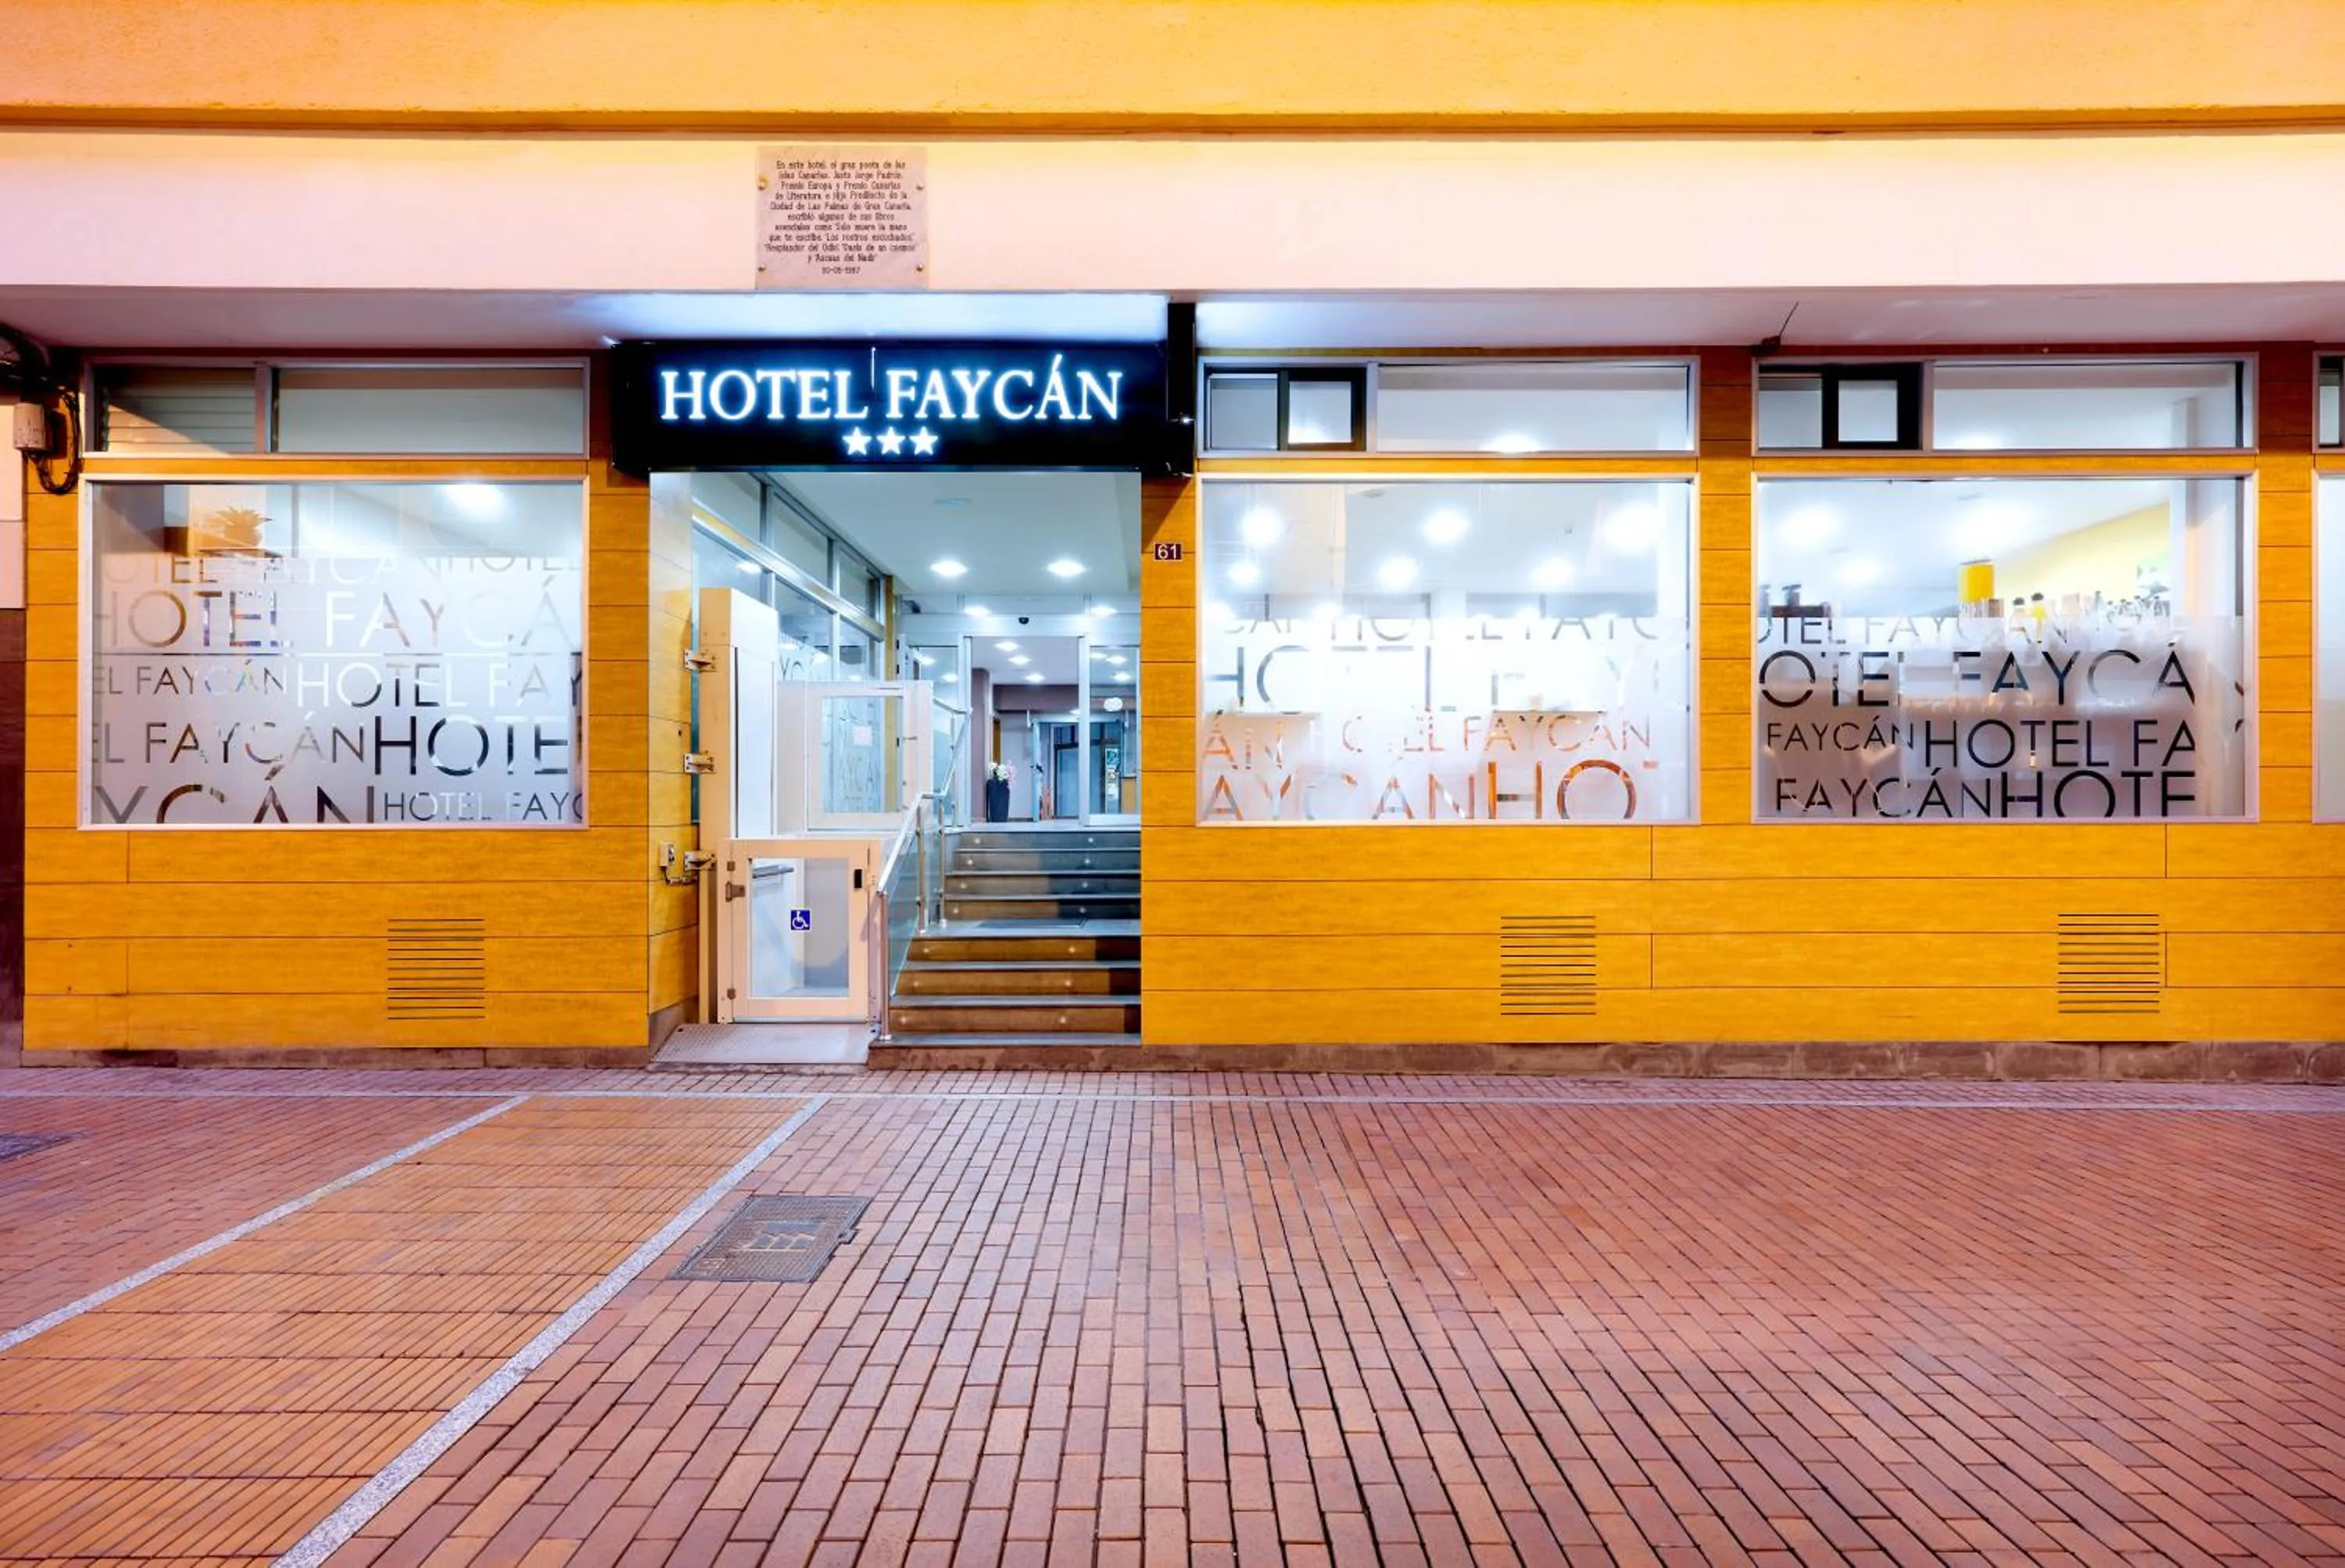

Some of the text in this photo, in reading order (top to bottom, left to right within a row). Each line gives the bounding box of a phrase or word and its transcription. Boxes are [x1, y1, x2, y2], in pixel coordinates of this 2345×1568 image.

[788, 160, 804, 170] este
[830, 159, 836, 170] el
[883, 159, 892, 170] de
[807, 181, 832, 192] Europa
[775, 192, 784, 200] de
[889, 191, 898, 200] de
[796, 202, 805, 210] de
[807, 202, 821, 210] Las
[853, 202, 861, 210] de
[865, 202, 880, 210] Gran
[848, 212, 857, 220] de
[661, 353, 1122, 420] HOTEL FAYCÁN
[1158, 543, 1176, 559] 61
[1767, 715, 1914, 752] FAYCÁN
[1925, 719, 2110, 768] HOTEL
[1775, 767, 1991, 818] FAYCÁN
